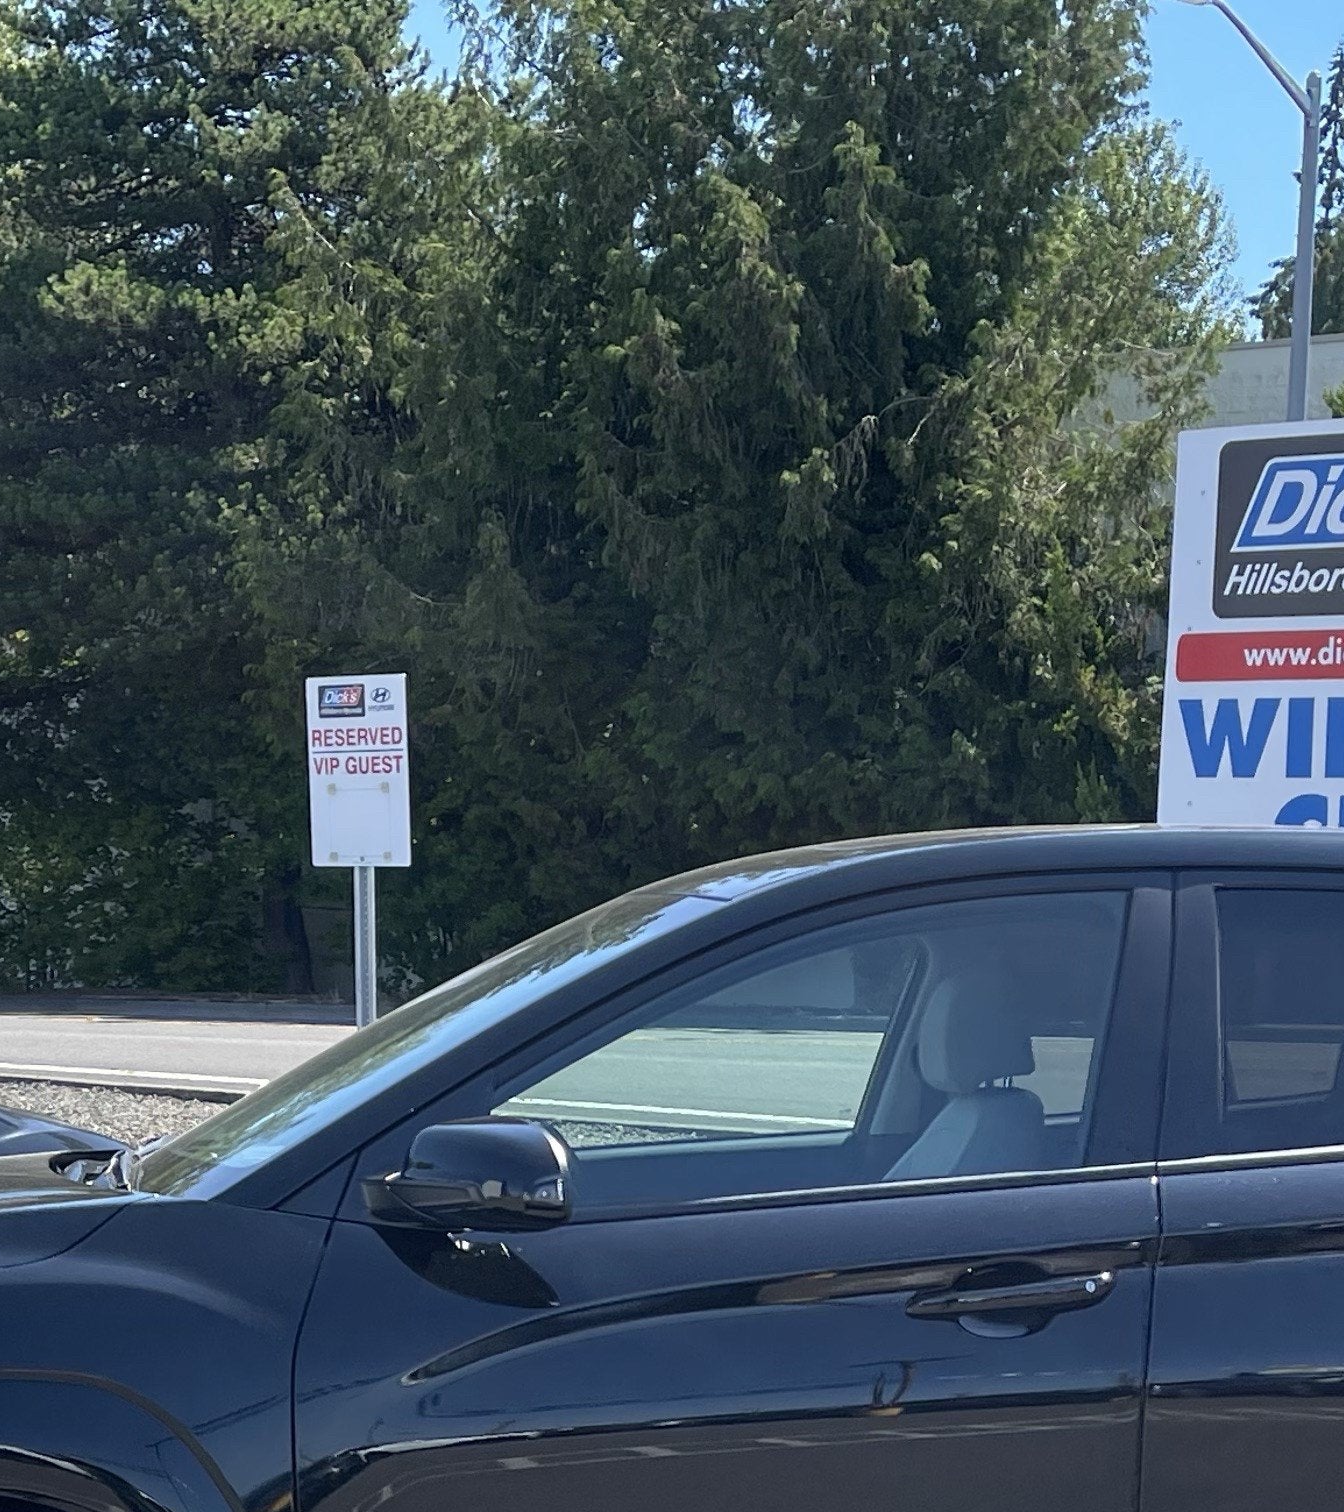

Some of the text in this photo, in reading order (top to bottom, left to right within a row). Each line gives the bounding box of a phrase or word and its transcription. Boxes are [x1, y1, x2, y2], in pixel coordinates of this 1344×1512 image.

[312, 726, 403, 748] RESERVED
[313, 755, 403, 775] VIP GUEST
